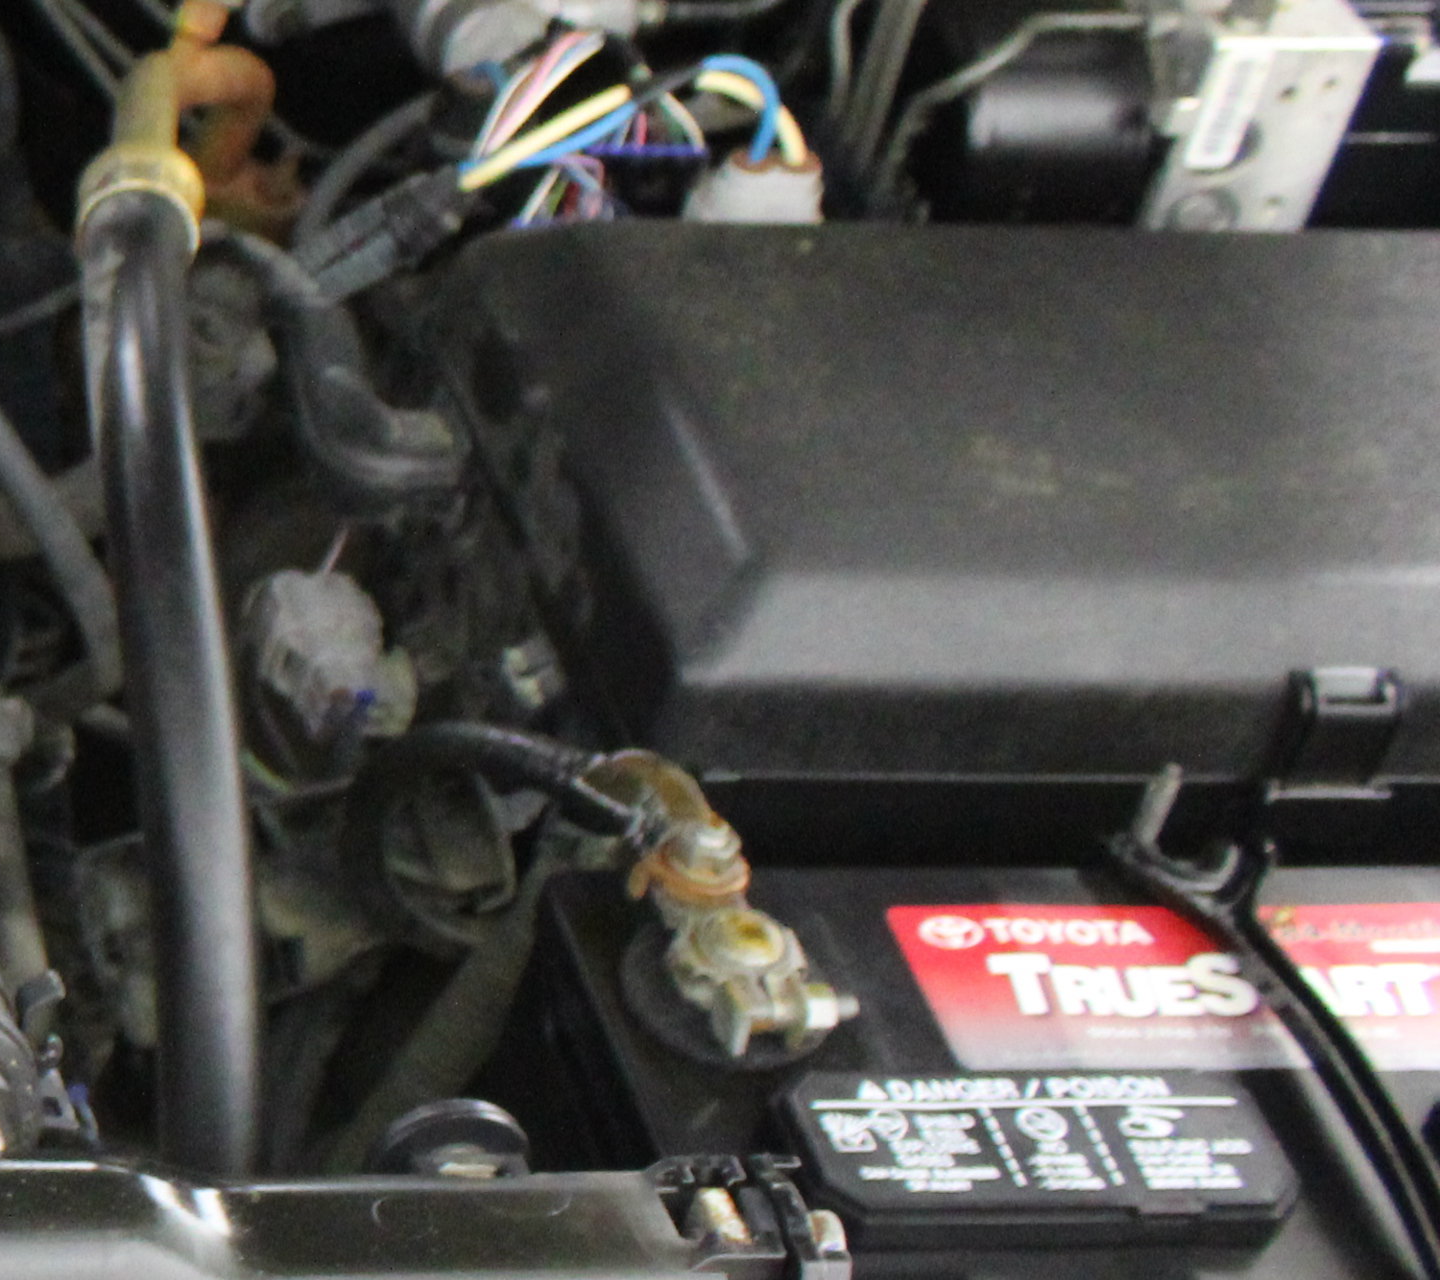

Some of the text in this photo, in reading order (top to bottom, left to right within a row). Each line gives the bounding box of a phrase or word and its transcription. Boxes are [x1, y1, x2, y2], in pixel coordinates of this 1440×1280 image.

[984, 917, 1156, 947] TOYOTA
[885, 1079, 1021, 1102] DANGER
[1046, 1076, 1171, 1098] POISON
